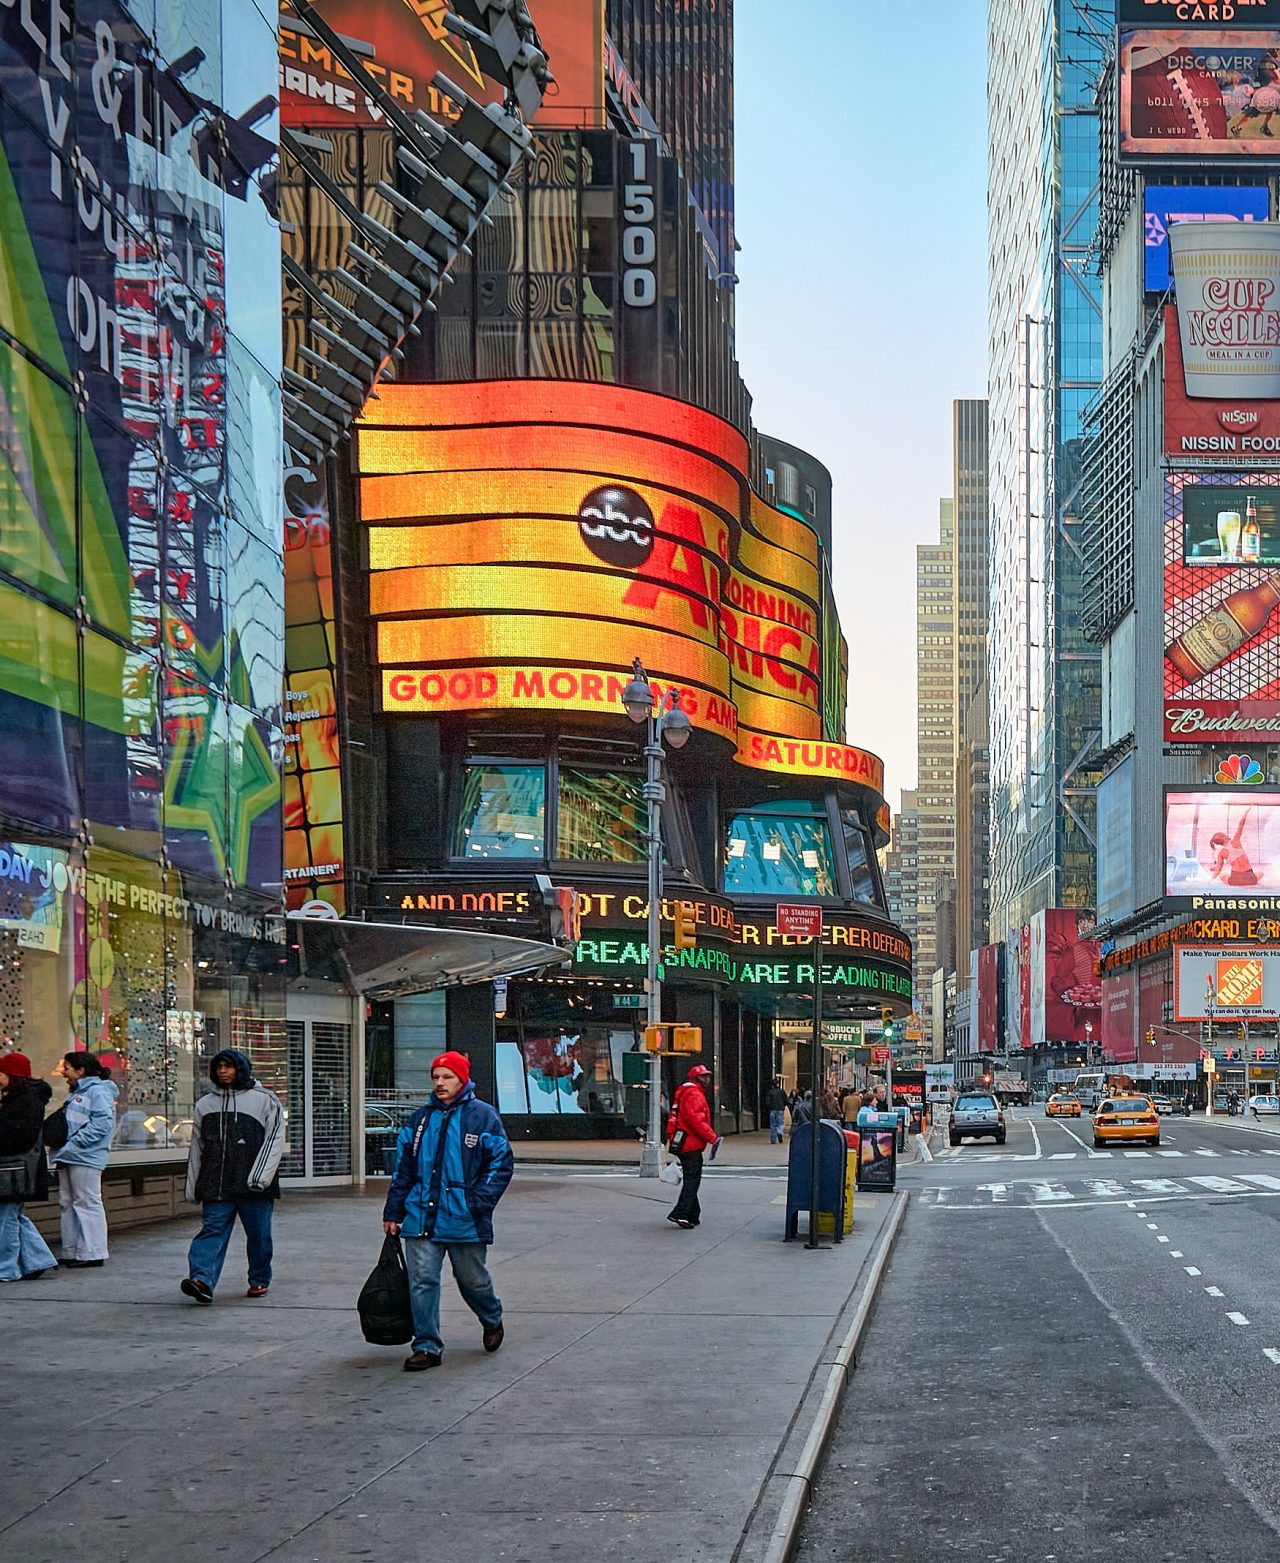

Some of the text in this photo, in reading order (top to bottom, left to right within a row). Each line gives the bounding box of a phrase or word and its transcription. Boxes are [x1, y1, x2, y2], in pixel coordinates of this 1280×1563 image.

[1176, 5, 1235, 20] CARD
[1167, 55, 1253, 70] DISCOVER
[622, 143, 656, 307] 1500
[1203, 277, 1275, 312] CUP
[1209, 351, 1270, 359] MEAL IN A CUP
[1222, 409, 1258, 424] NISSIN
[1181, 436, 1236, 450] NISSIN
[579, 504, 652, 547] abc
[389, 671, 498, 702] GOOD
[285, 690, 308, 701] Boys
[285, 709, 320, 722] Rejects
[39, 859, 87, 898] JOY!
[95, 873, 126, 906] THE
[130, 884, 190, 921] PERFECT
[193, 903, 217, 927] TOY
[780, 908, 819, 917] NO STANDING
[785, 917, 815, 925] ANYTIME
[740, 963, 790, 984] ARE
[797, 964, 879, 989] READING
[1222, 964, 1241, 981] THE
[1218, 960, 1262, 1004] HOME
[1234, 977, 1263, 1005] DEPOT
[827, 1026, 860, 1034] RBUCKS
[828, 1033, 852, 1042] OFFEE
